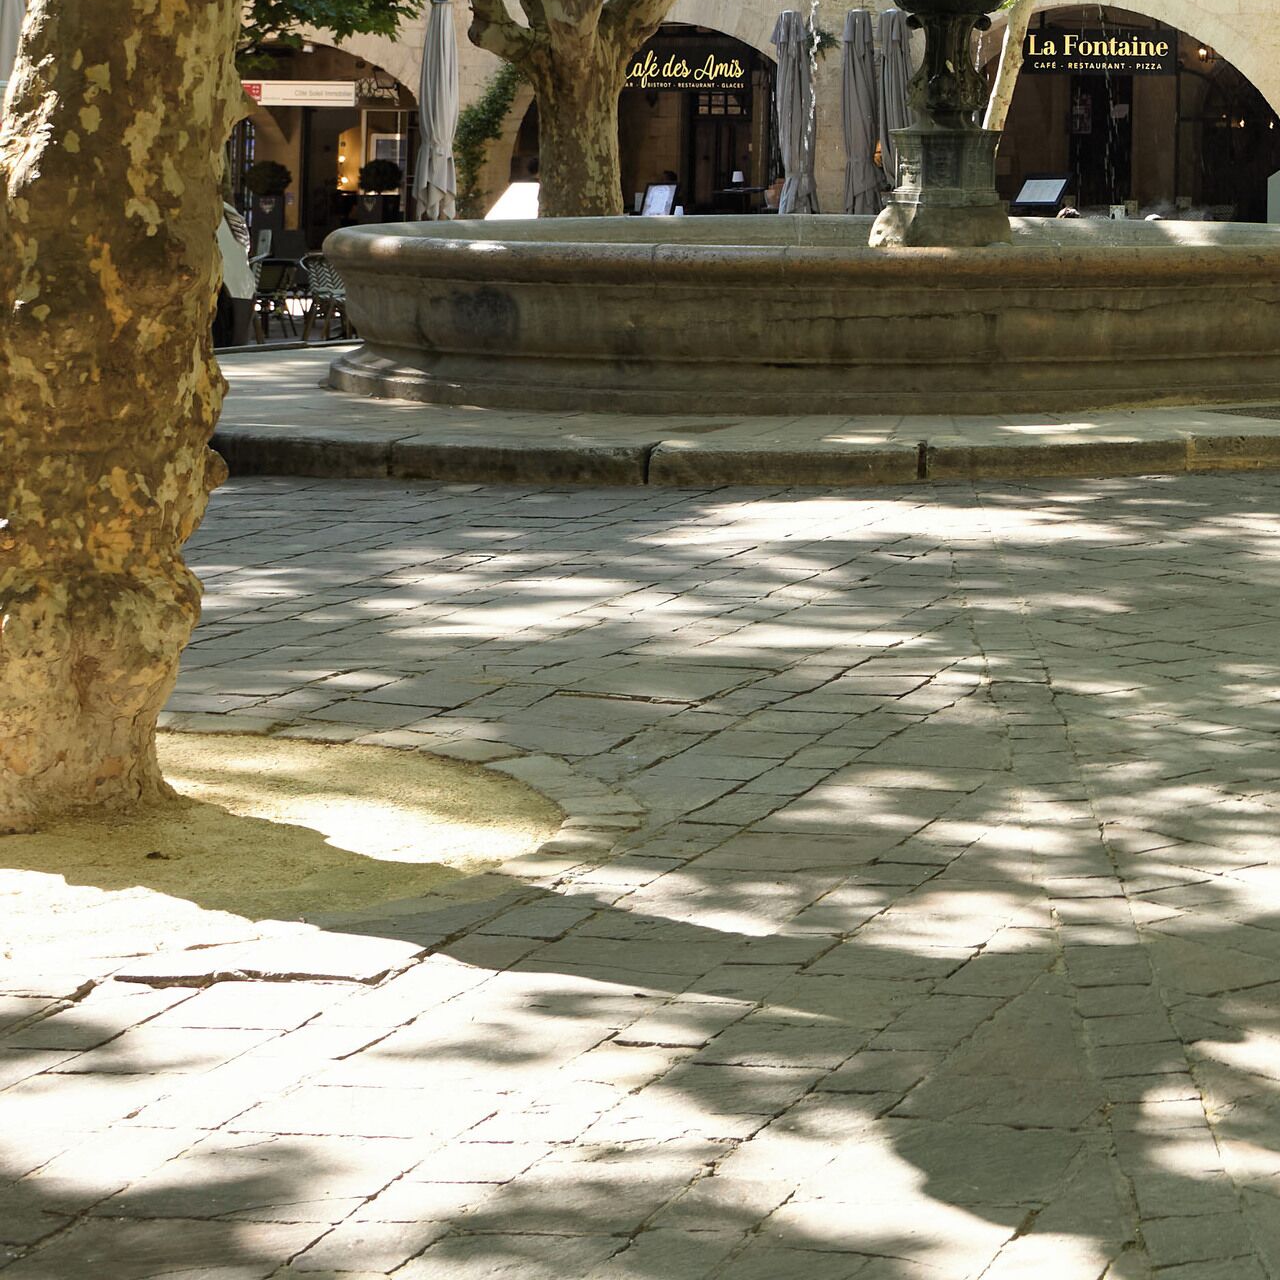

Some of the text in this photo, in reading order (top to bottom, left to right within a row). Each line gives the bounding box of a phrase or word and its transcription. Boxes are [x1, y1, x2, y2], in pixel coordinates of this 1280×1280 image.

[1028, 34, 1169, 57] La Fontaine
[625, 50, 745, 89] afé des Amis
[1034, 61, 1057, 70] CAFÉ
[1068, 62, 1125, 70] RESTAURANT
